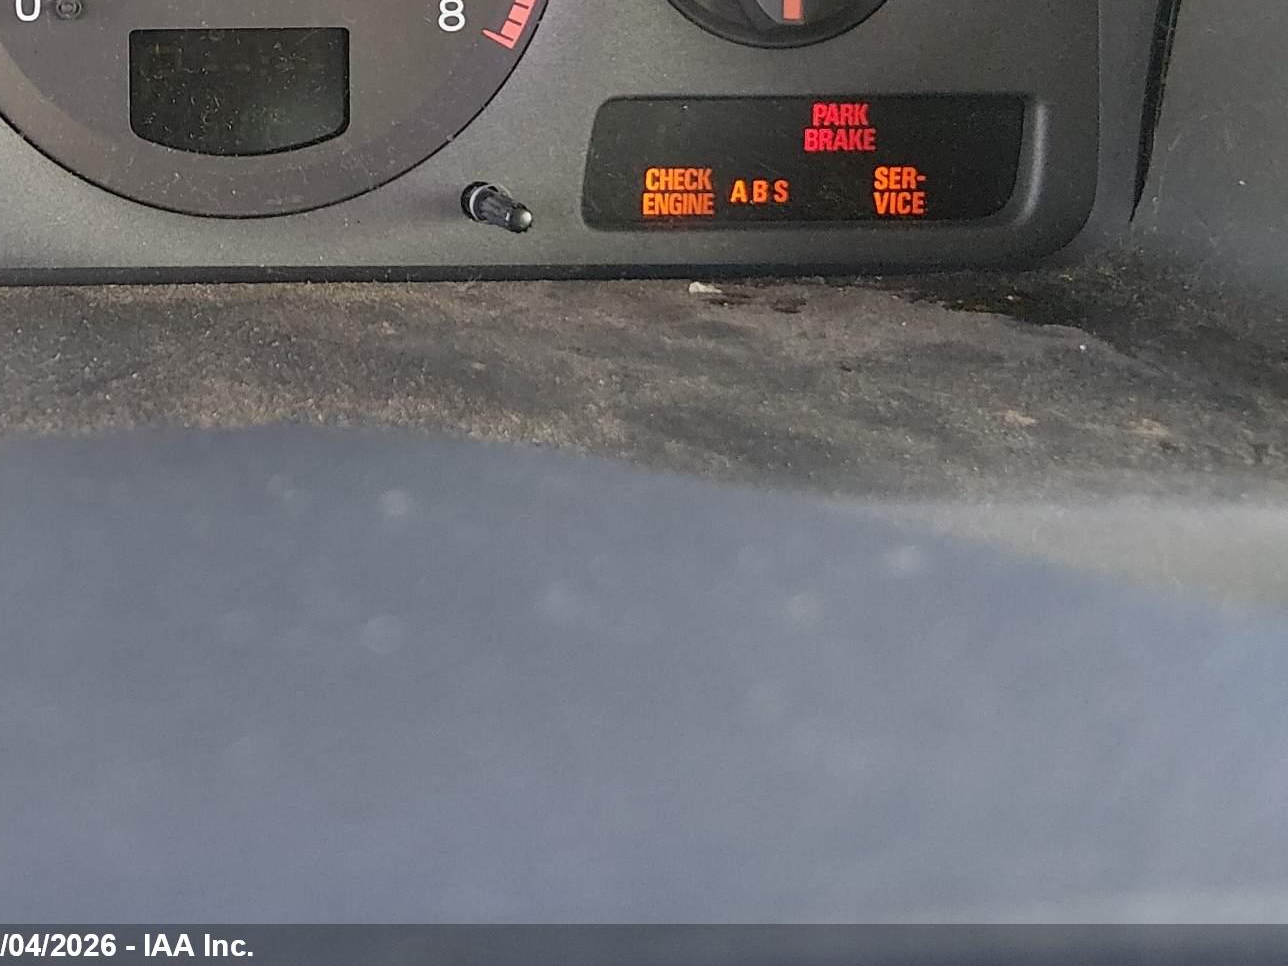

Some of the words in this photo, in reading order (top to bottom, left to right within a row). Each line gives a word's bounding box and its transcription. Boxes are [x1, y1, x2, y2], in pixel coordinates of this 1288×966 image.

[813, 104, 869, 126] PARK
[804, 129, 875, 151] BRAKE
[645, 169, 711, 191] CHECK
[874, 167, 926, 189] SER-
[643, 193, 714, 215] ENGINE
[875, 192, 924, 214] VICE
